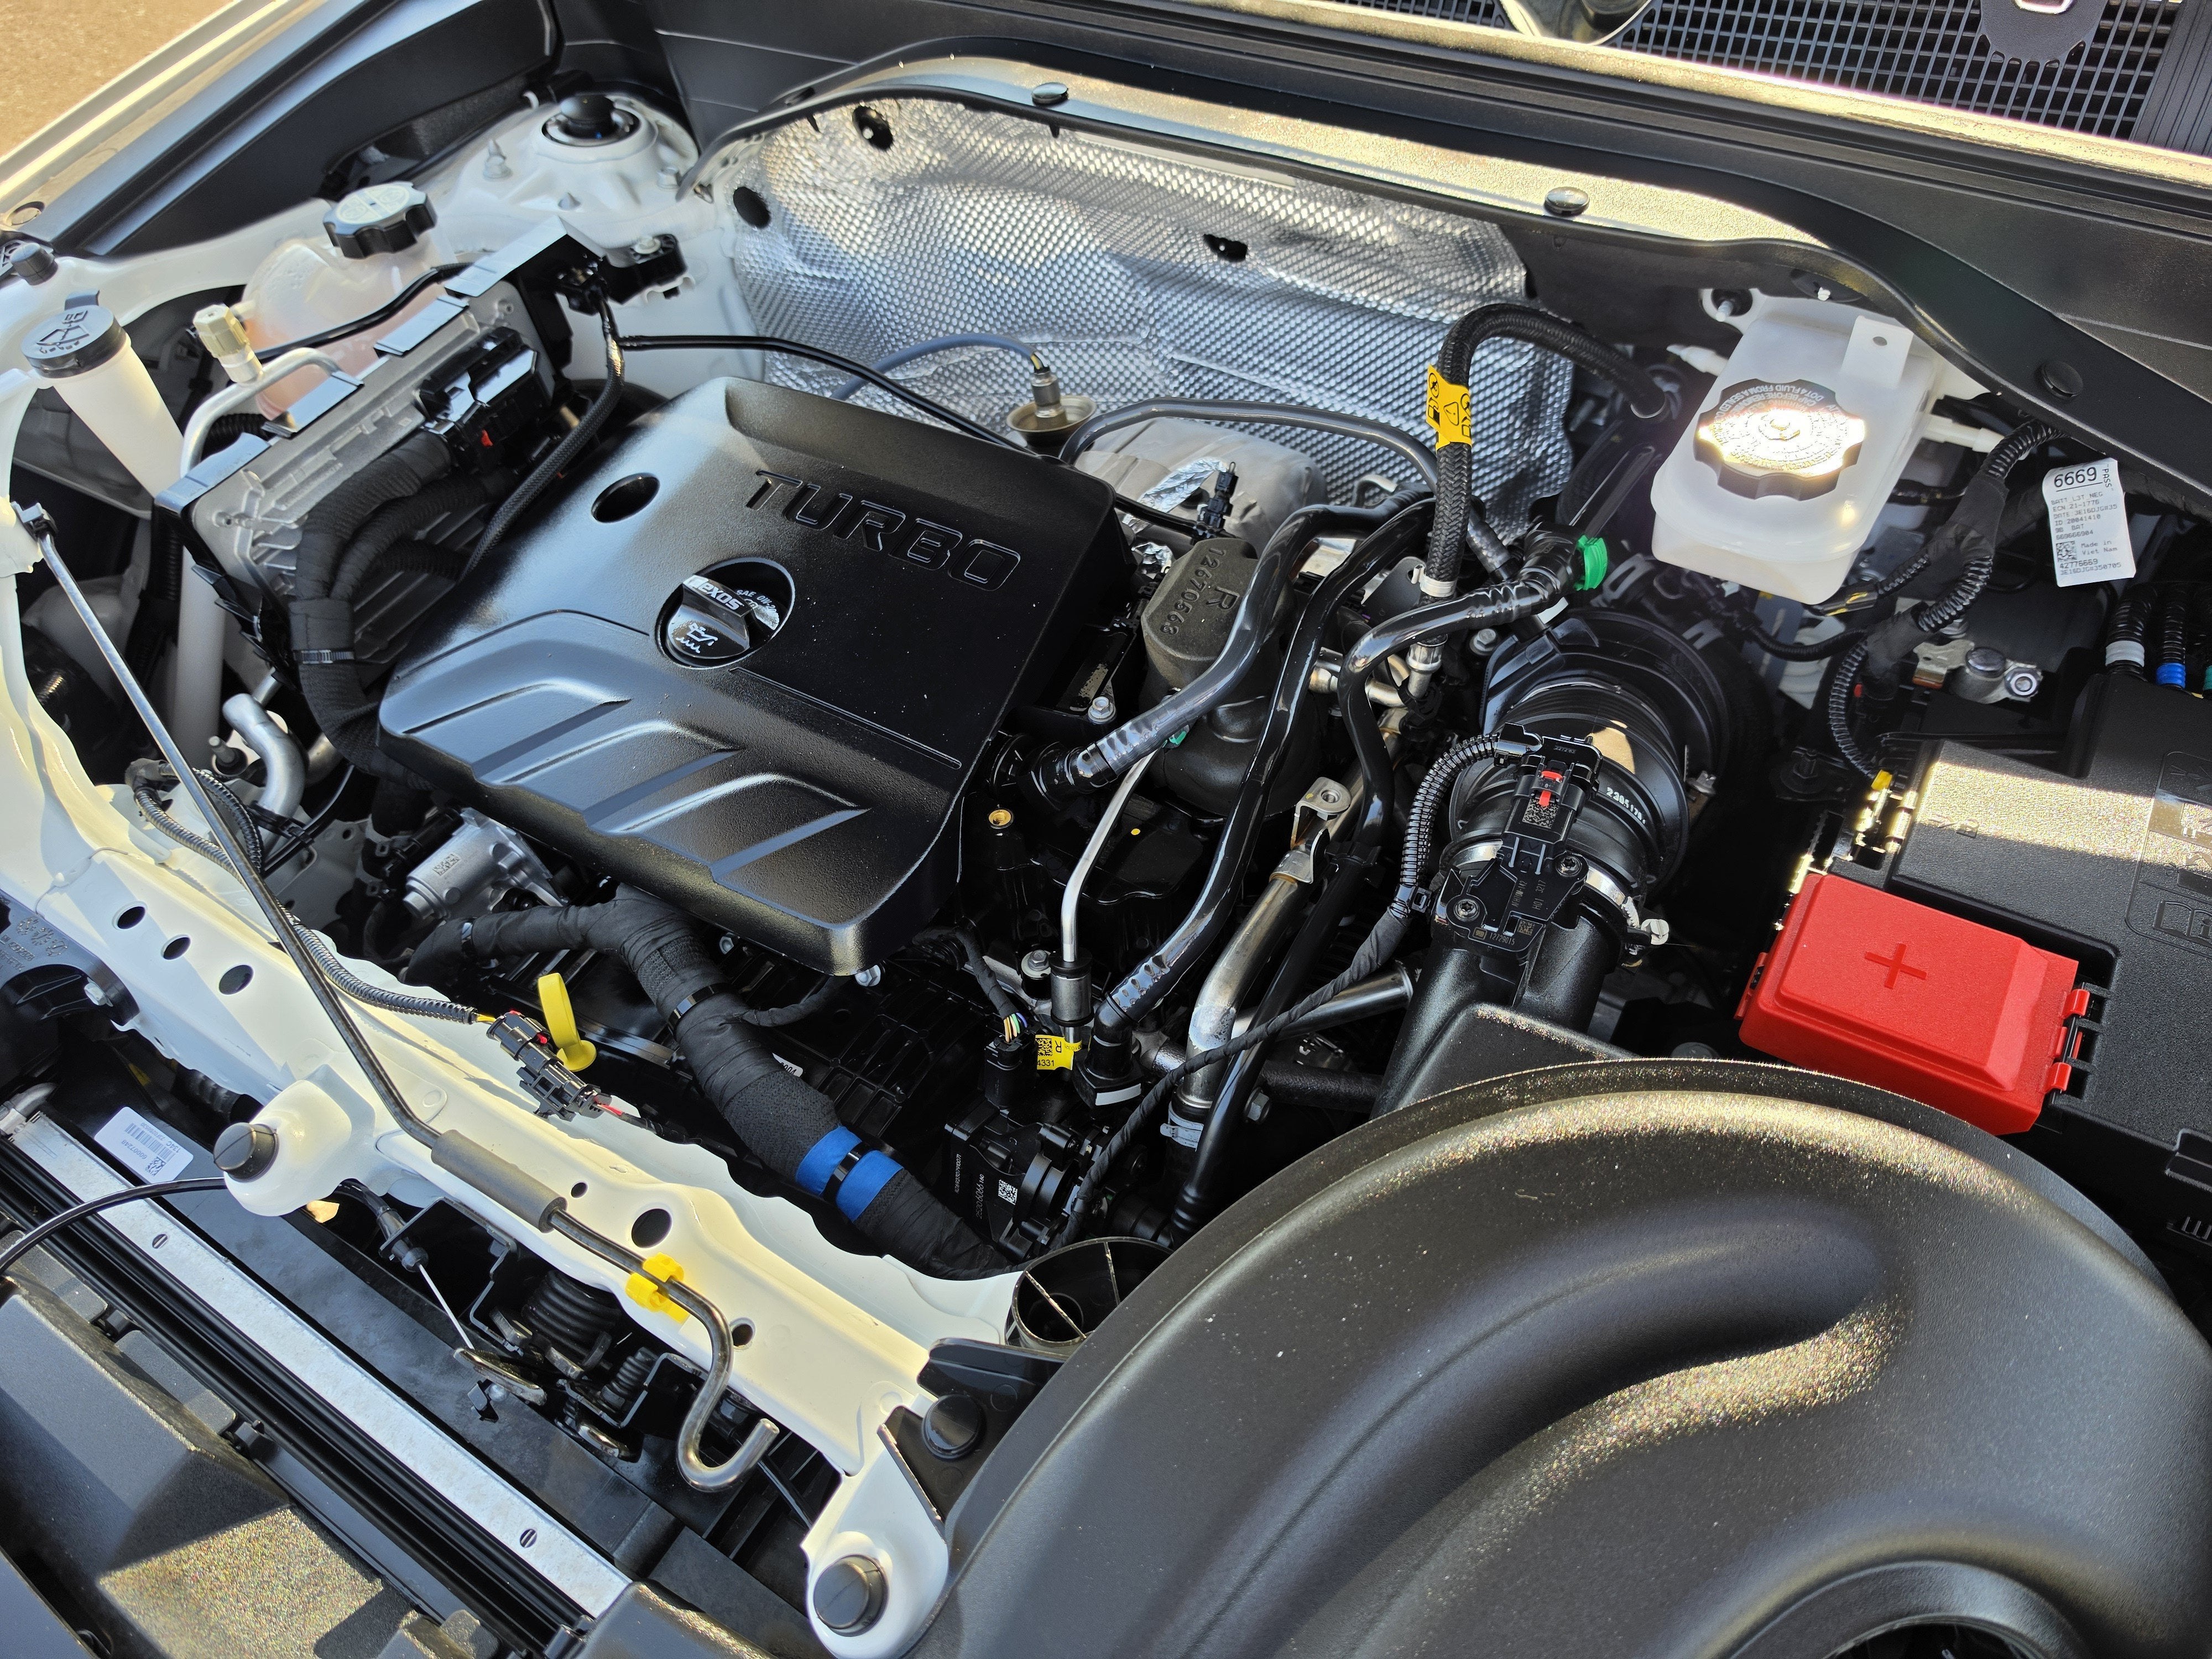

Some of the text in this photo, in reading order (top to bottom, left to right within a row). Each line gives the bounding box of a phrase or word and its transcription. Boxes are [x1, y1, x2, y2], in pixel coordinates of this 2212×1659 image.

[1764, 392, 1798, 401] BEFORE
[2054, 466, 2097, 488] 6669
[746, 469, 1021, 591] TURBO
[1160, 547, 1227, 635] 12670563
[1206, 586, 1240, 611] R
[1055, 1040, 1062, 1053] R
[165, 1141, 182, 1154] 134C
